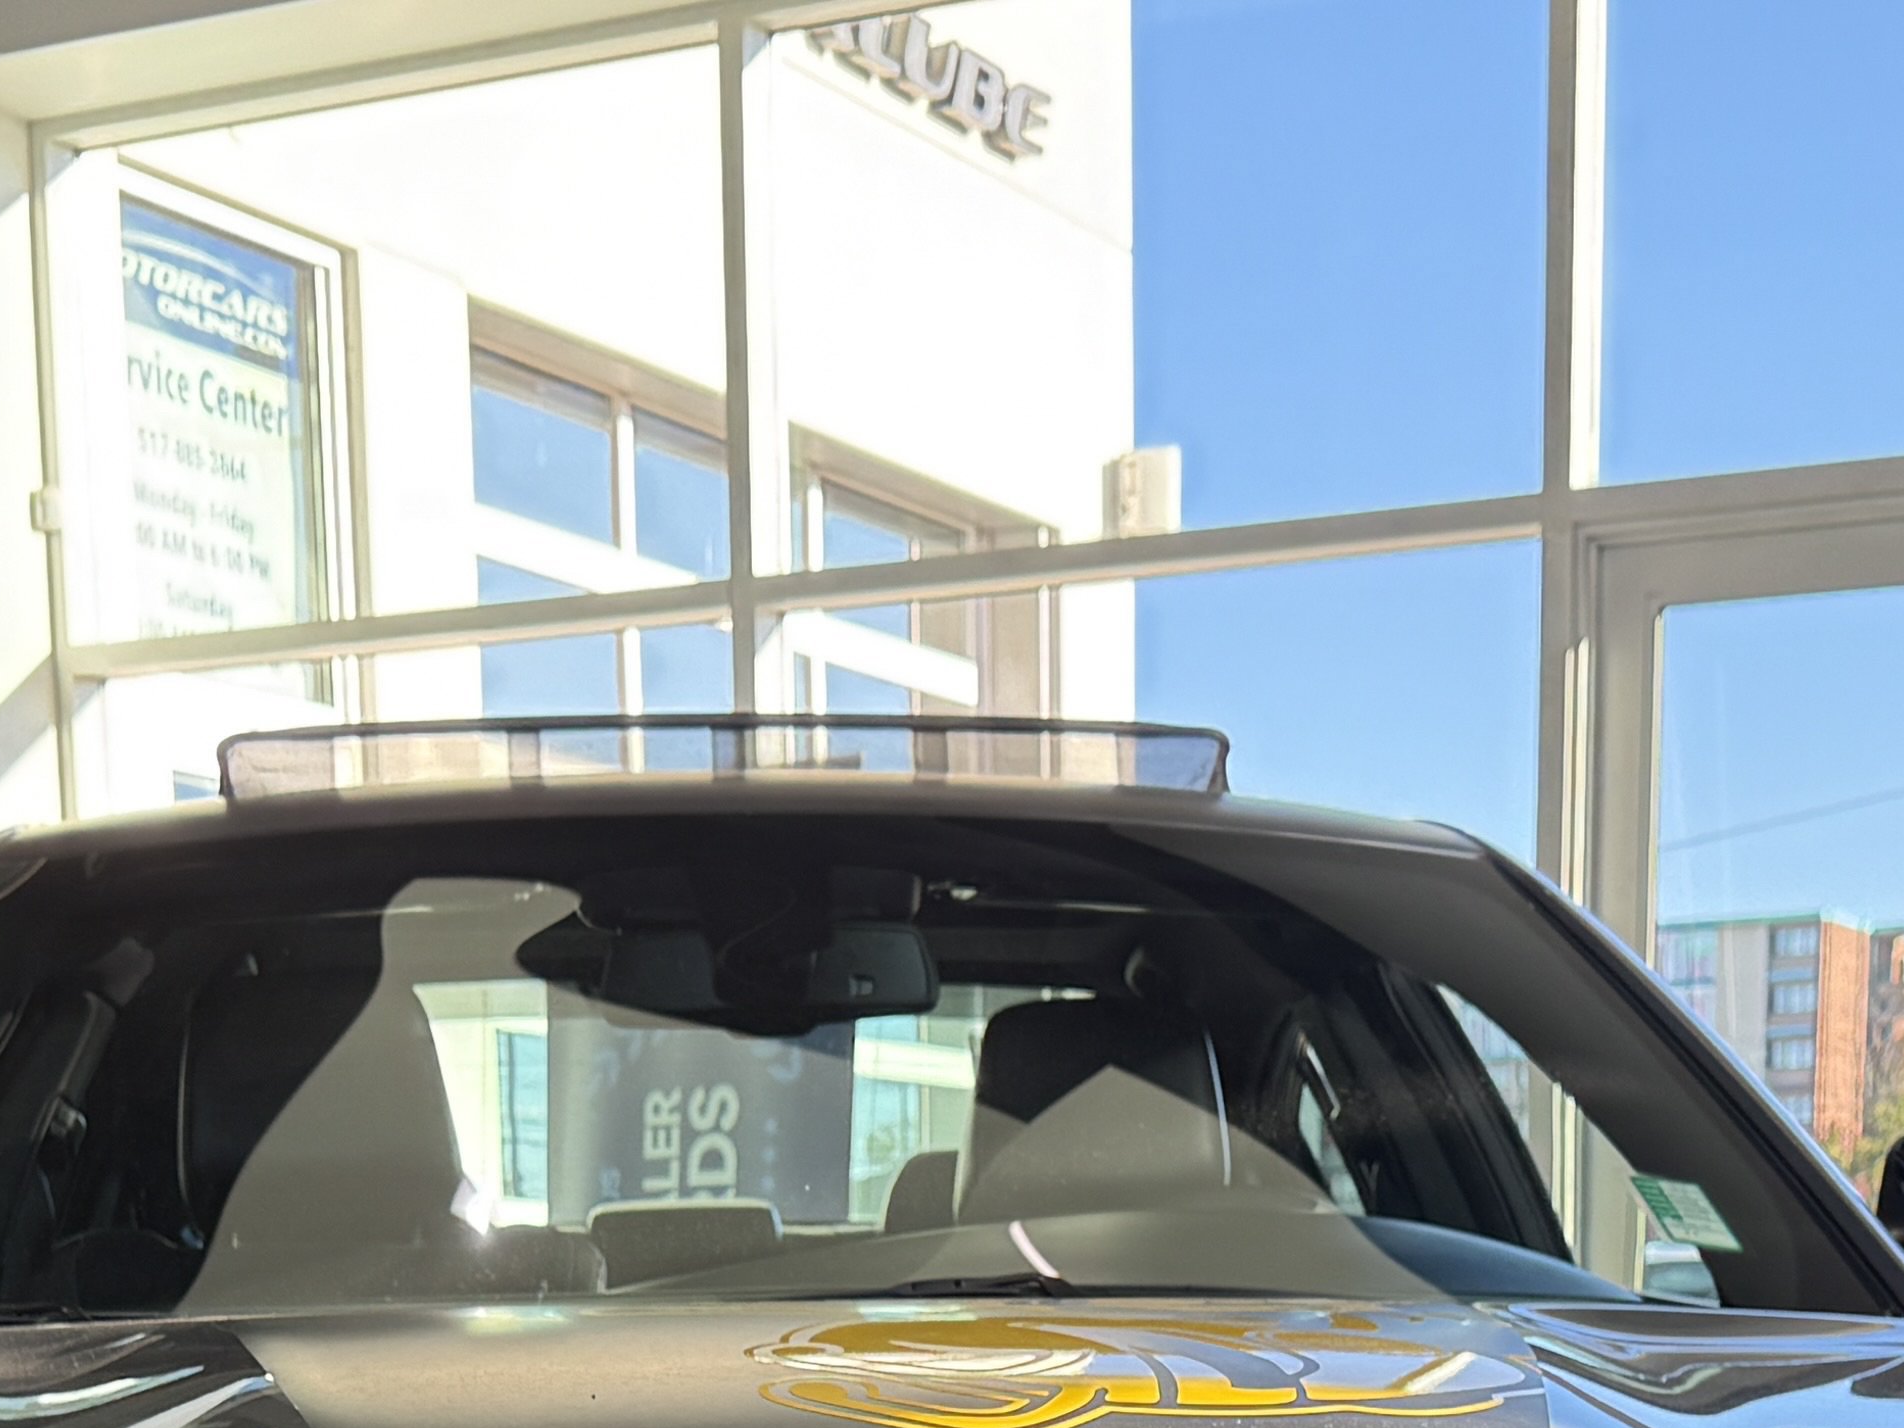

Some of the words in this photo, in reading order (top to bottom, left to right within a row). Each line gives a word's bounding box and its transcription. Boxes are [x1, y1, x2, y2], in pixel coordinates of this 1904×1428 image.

[808, 12, 1051, 155] LUBE
[122, 248, 288, 337] OTORCARS
[127, 350, 190, 405] rvice
[199, 368, 289, 437] Center
[642, 1085, 682, 1200] LER
[687, 1082, 740, 1200] DS
